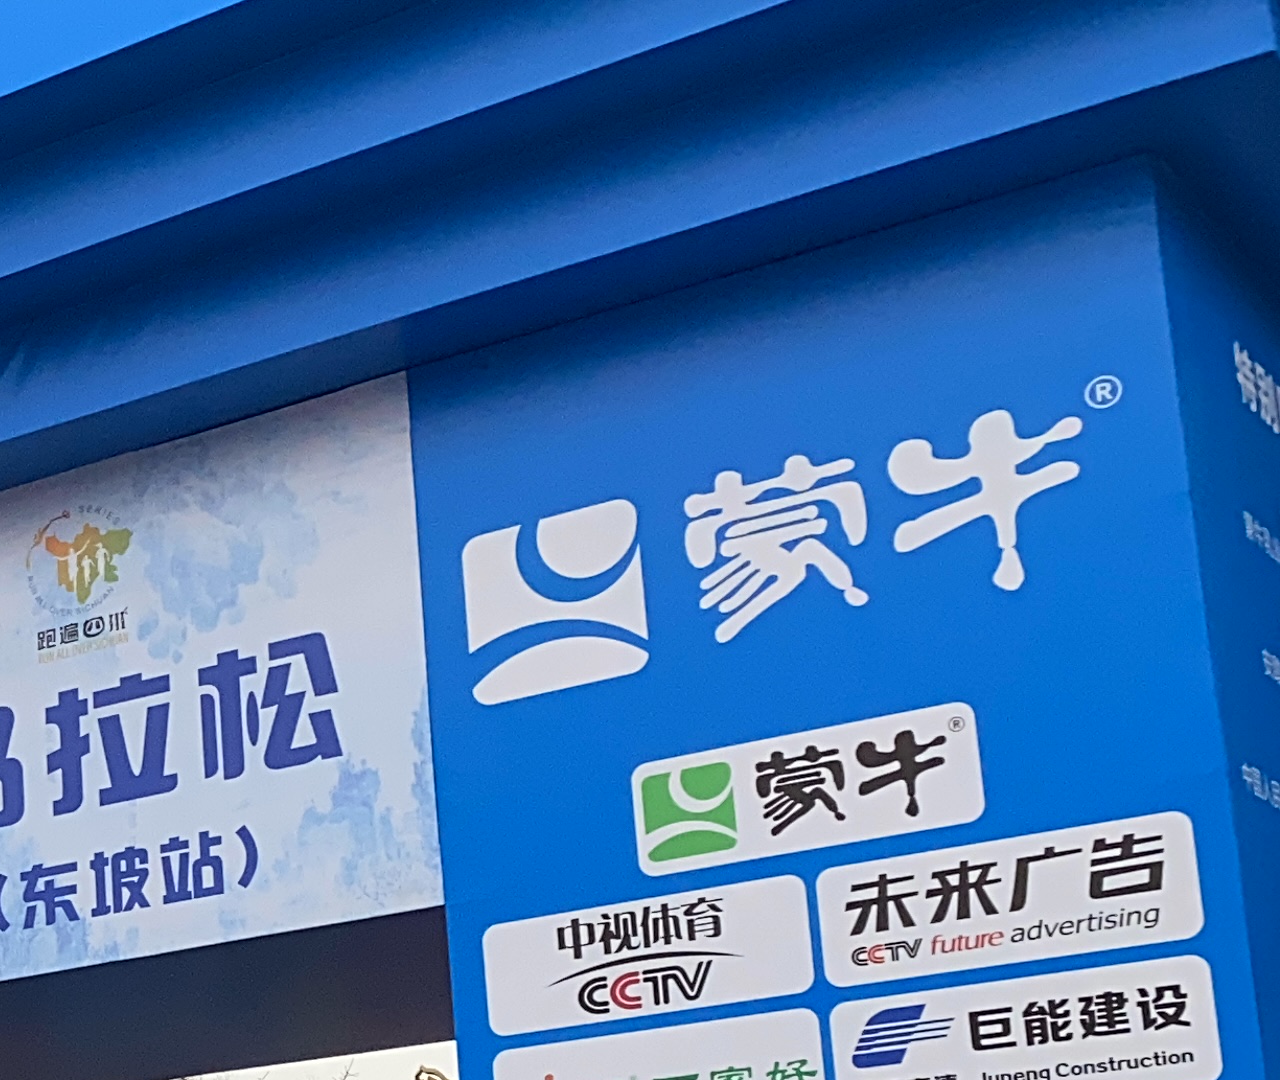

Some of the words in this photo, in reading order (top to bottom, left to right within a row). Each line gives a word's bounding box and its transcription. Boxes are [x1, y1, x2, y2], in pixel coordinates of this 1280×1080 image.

[685, 410, 1082, 643] 蒙牛
[37, 607, 128, 651] 跑遍四川
[756, 730, 949, 836] 蒙牛
[845, 833, 1165, 938] 未来广告
[557, 896, 724, 961] 中视体育
[851, 938, 923, 967] CCTV
[931, 926, 1004, 956] future
[1010, 904, 1160, 946] advertising
[577, 960, 713, 1015] CCTV
[968, 984, 1192, 1052] 巨能建设
[1056, 1046, 1194, 1080] Construction
